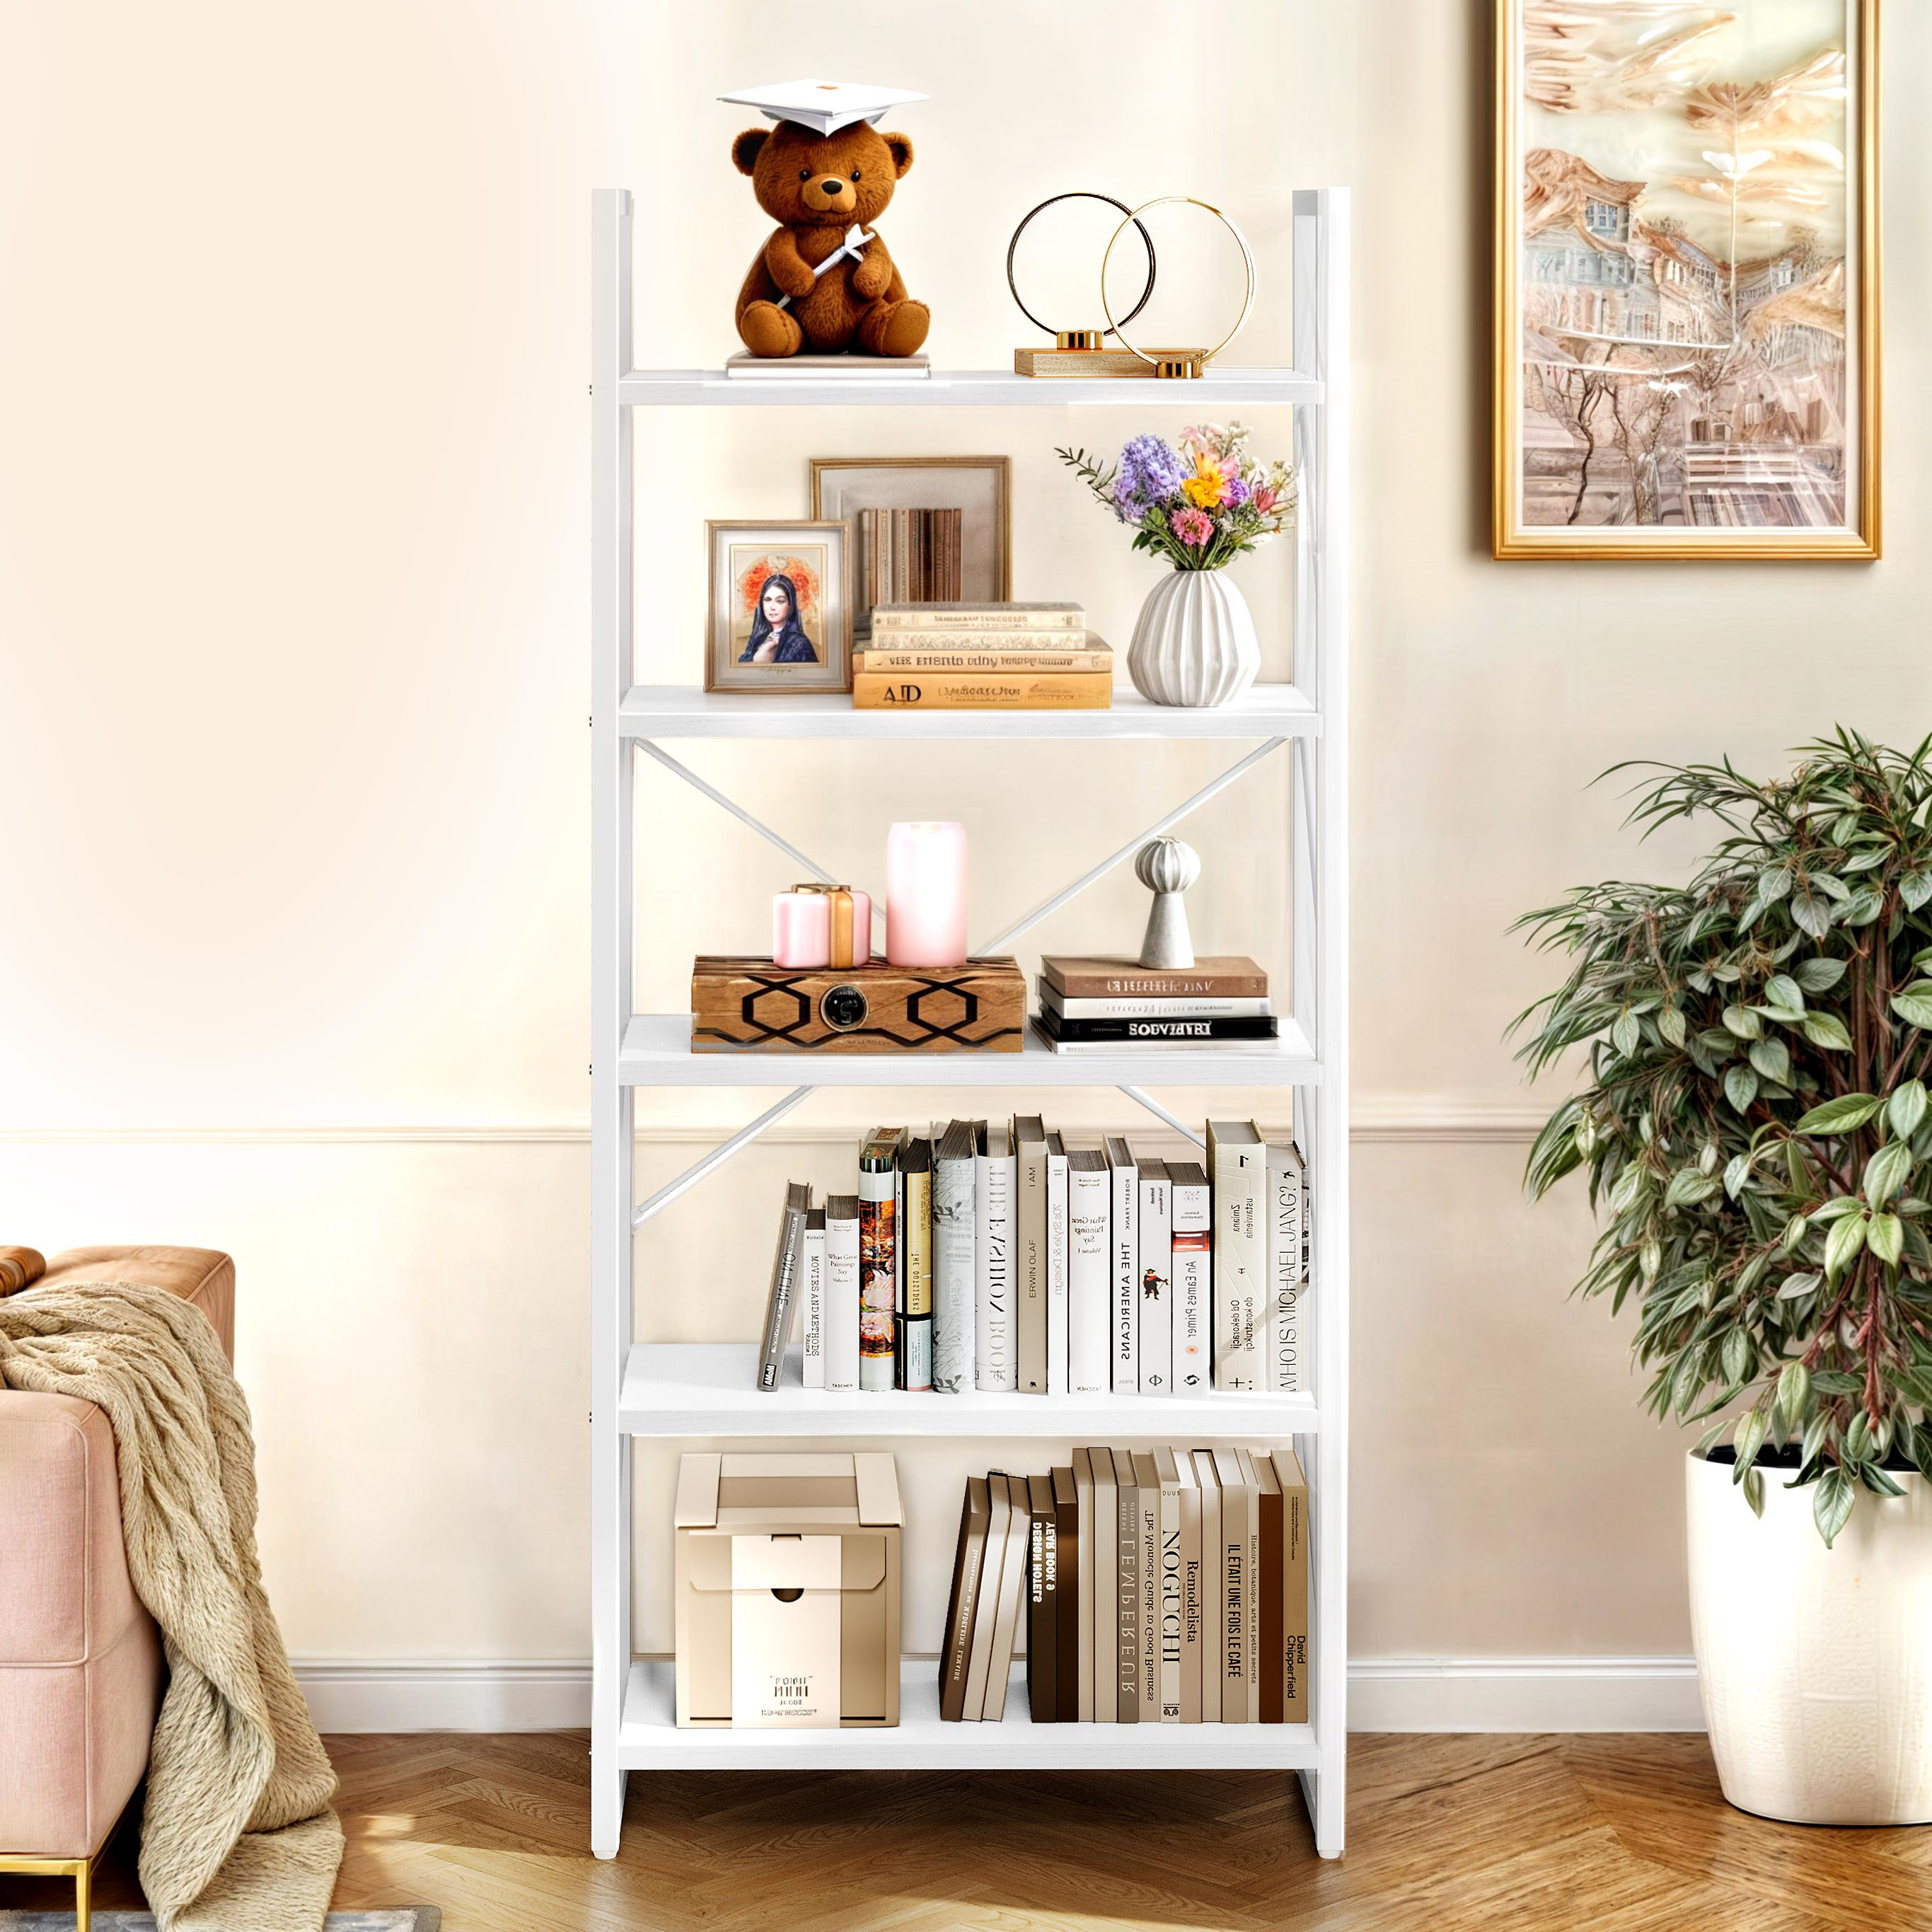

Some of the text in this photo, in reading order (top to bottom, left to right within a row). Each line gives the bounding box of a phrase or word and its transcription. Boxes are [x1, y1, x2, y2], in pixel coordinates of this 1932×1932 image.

[1029, 1167, 1036, 1181] AM
[1279, 1186, 1297, 1392] WHO IS MICHAEL JANG?
[1162, 1529, 1181, 1664] NOGUCHI
[1186, 1561, 1199, 1643] Remodelista
[1227, 1544, 1244, 1677] IL ÉTAIT UNE FOIS LE CAFÉ
[1285, 1635, 1296, 1699] Chipperfield
[1297, 1636, 1306, 1664] David
